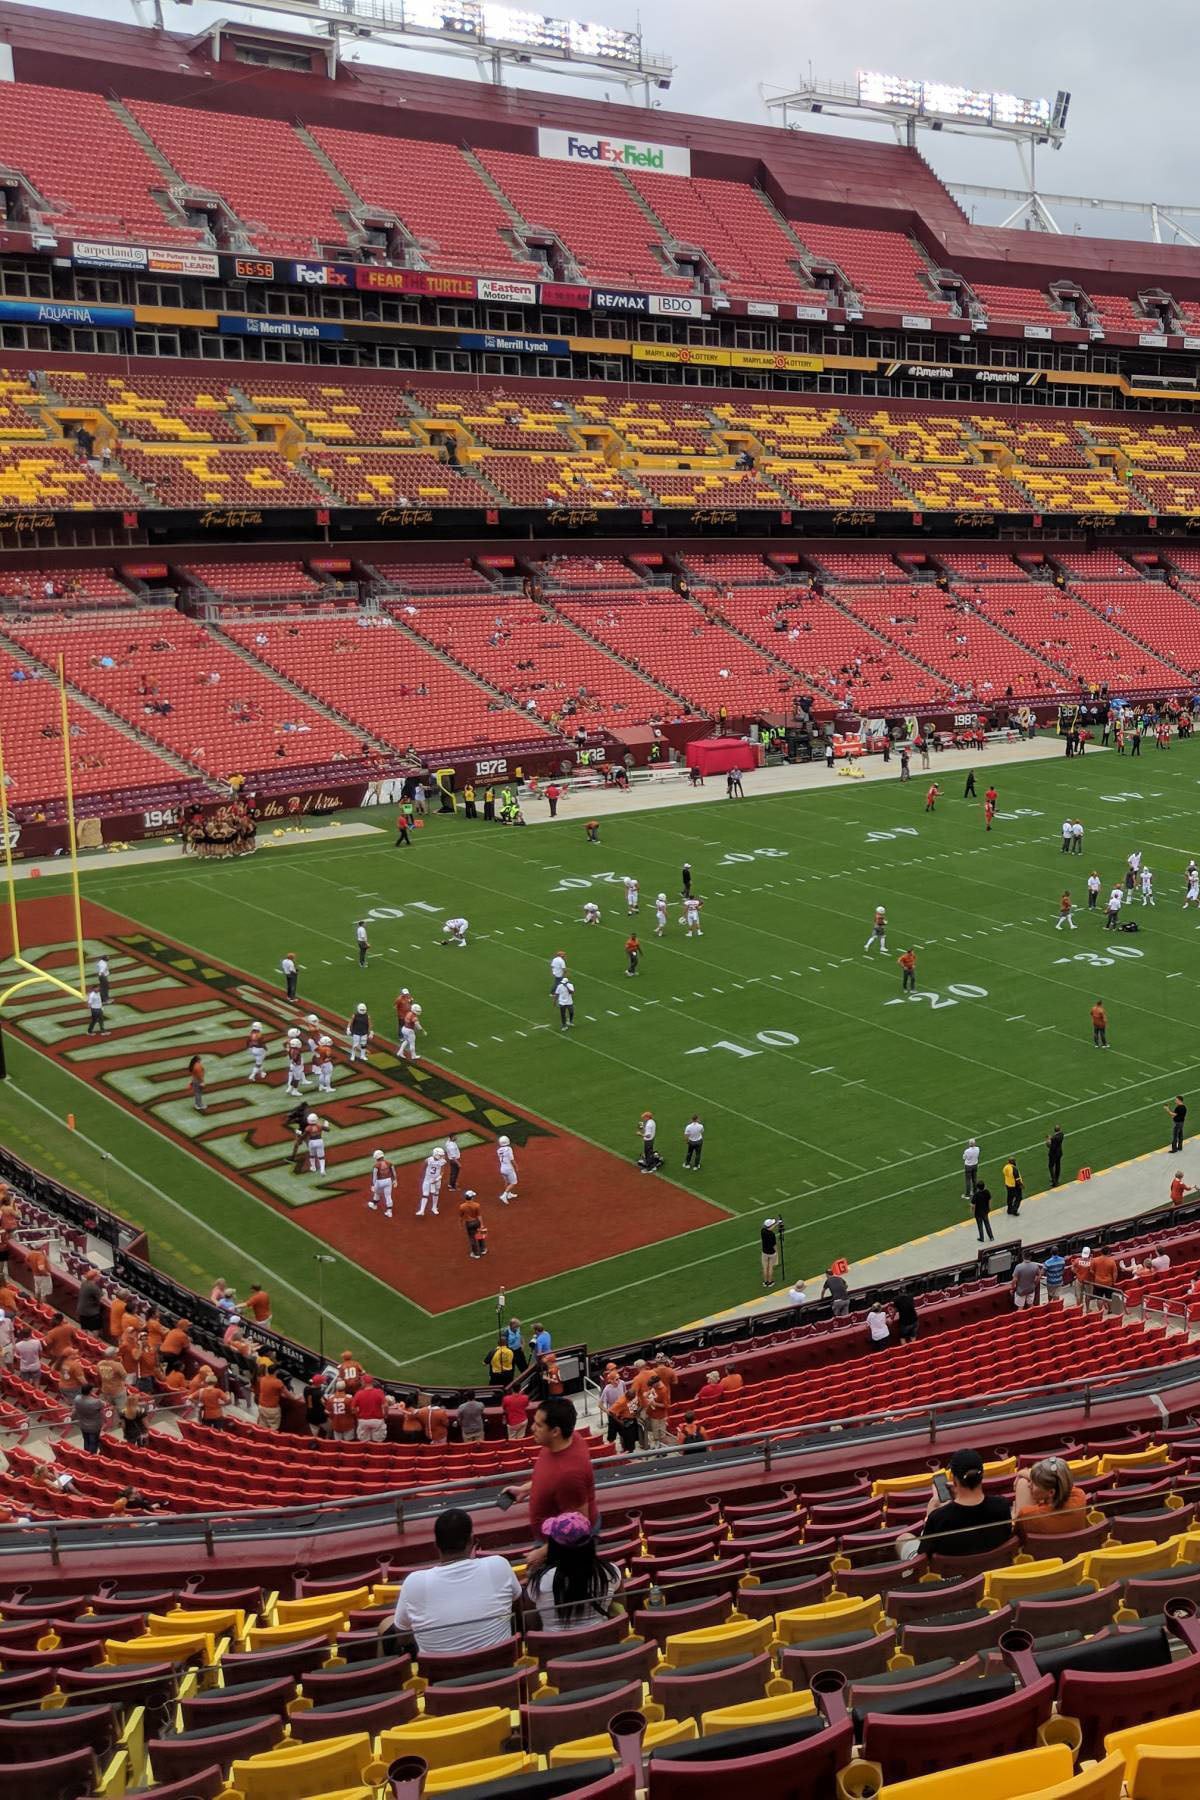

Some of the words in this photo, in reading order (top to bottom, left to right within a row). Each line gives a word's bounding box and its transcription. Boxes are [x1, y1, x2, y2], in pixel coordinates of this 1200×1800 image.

[568, 137, 664, 168] FedExField
[77, 243, 133, 259] Carpetland
[296, 264, 347, 286] FedEx
[483, 291, 513, 301] Motors
[490, 283, 532, 294] Eastern
[597, 294, 645, 309] RE/MAX
[662, 299, 692, 312] BDO
[39, 306, 91, 323] AQUAFINA
[260, 322, 290, 335] Merrill
[292, 324, 320, 337] Lynch
[497, 338, 522, 350] Merrill
[524, 340, 548, 352] Lynch
[645, 348, 678, 358] MARYLAND
[476, 759, 507, 776] 1972
[264, 802, 284, 817] the
[1073, 945, 1146, 967] 30
[906, 983, 989, 1009] 20
[712, 1030, 801, 1059] 10
[430, 1166, 437, 1176] 3
[249, 1329, 281, 1350] FANTASY
[282, 1344, 304, 1363] SEATS
[345, 1367, 357, 1379] 10
[333, 1402, 346, 1415] 12
